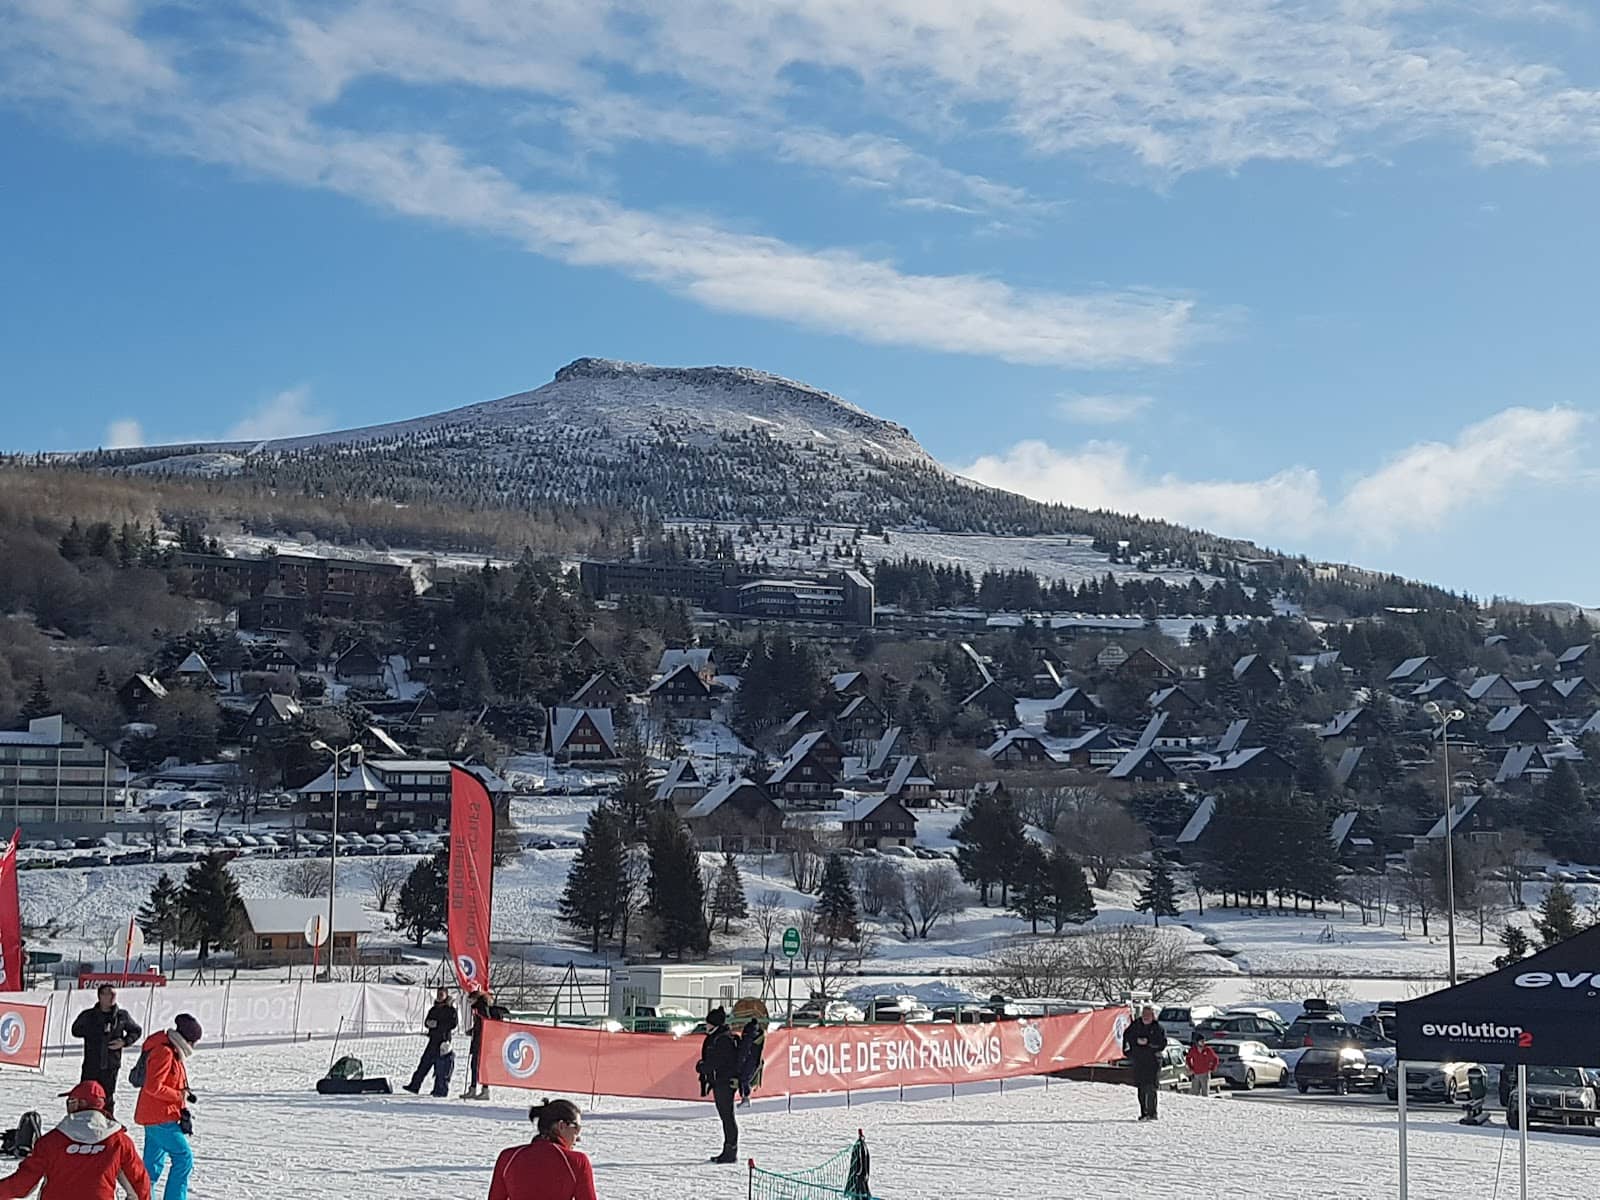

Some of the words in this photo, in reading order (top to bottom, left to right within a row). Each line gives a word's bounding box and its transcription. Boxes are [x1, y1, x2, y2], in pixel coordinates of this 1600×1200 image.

[789, 1037, 852, 1077] ÉCOLE
[857, 1041, 881, 1072] DE
[886, 1040, 915, 1070] SKI
[919, 1036, 1001, 1072] FRANÇAIS
